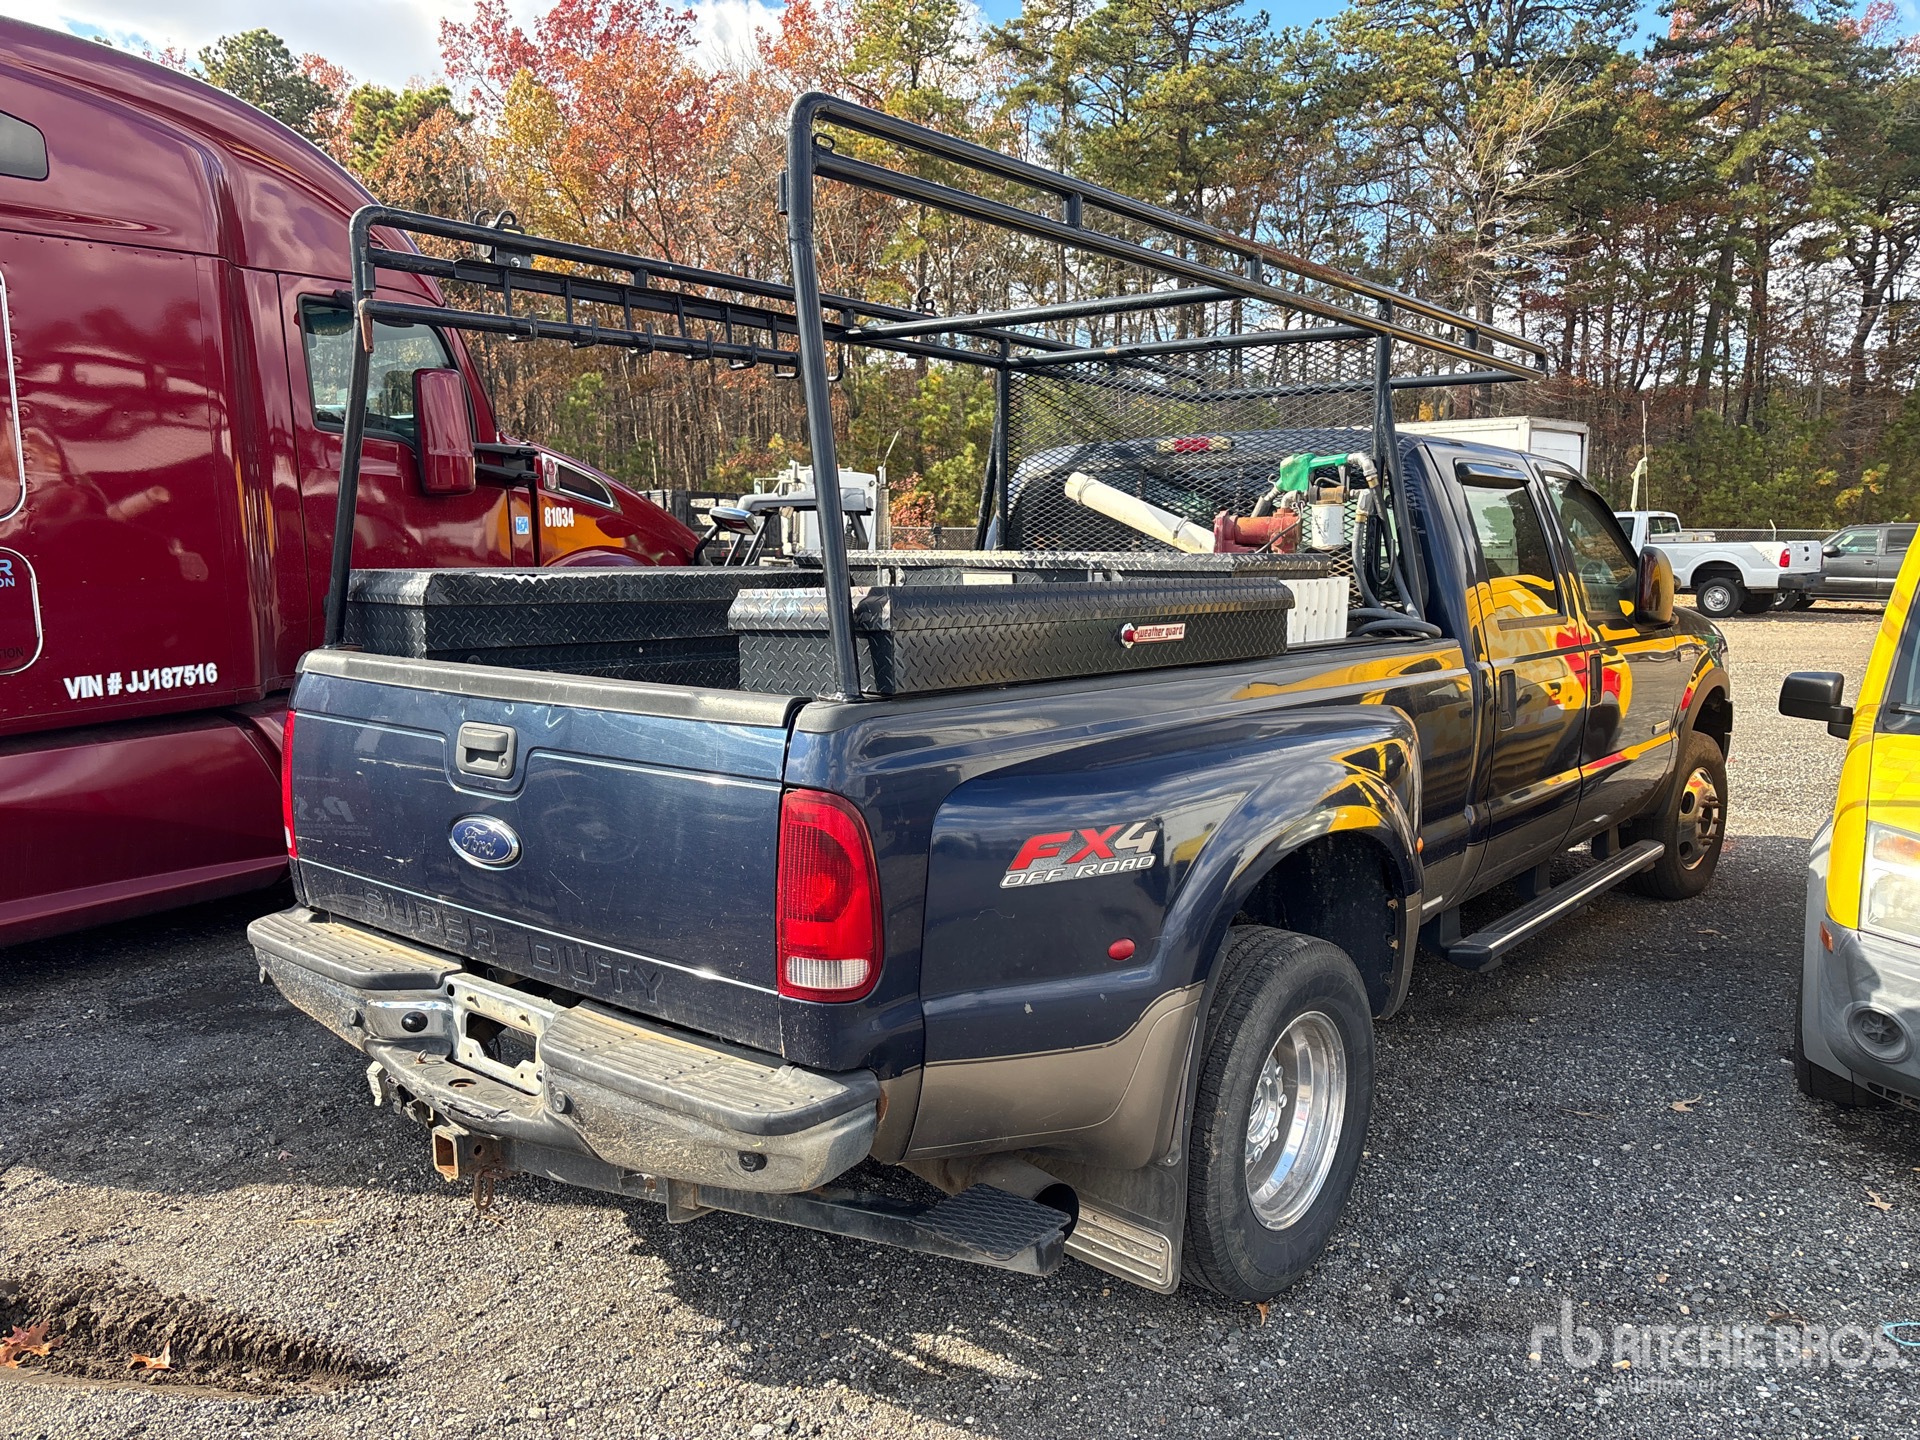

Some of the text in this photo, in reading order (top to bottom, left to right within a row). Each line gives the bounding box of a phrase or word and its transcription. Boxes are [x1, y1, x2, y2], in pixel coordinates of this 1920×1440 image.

[544, 506, 575, 528] 81034
[1139, 625, 1184, 639] weather guard
[63, 662, 218, 700] VIN # JJ187516
[462, 826, 496, 856] Ford
[1008, 821, 1158, 871] FX4
[1001, 855, 1156, 887] OFF ROAD
[363, 886, 664, 1004] SUPER DUTY
